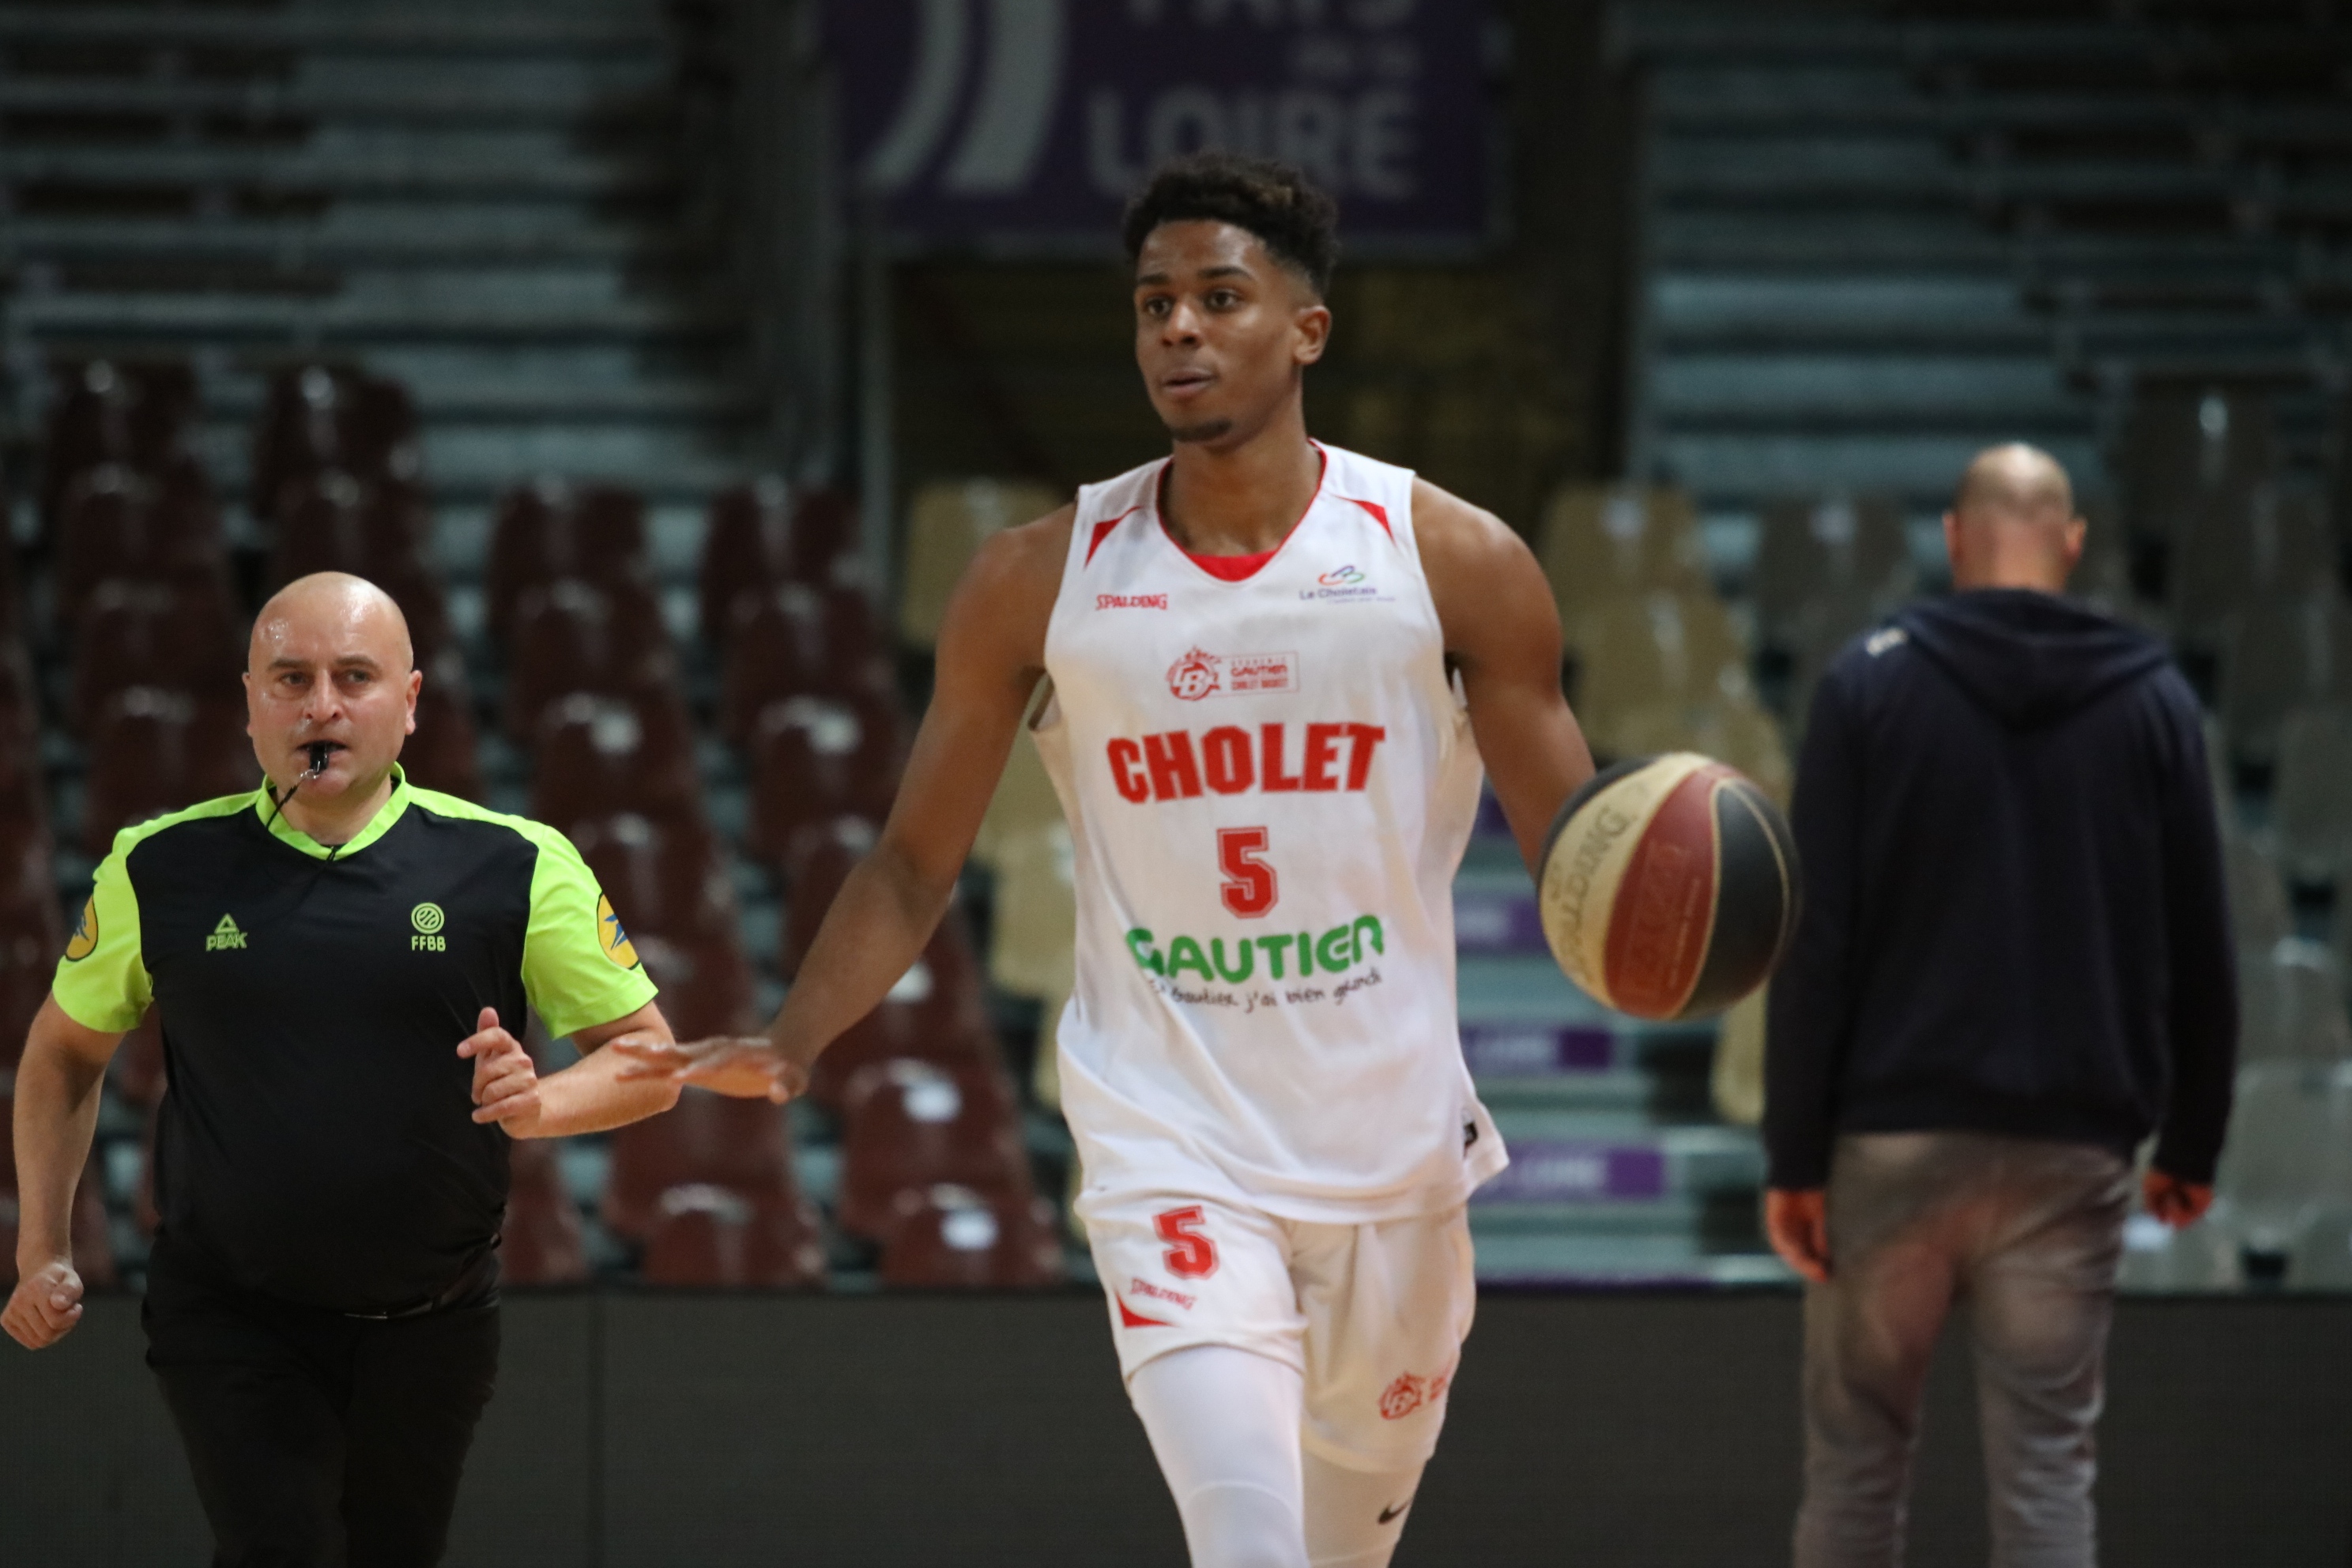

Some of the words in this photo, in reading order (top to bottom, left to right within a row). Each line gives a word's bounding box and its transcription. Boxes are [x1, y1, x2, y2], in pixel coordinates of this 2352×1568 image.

[1095, 594, 1167, 611] SPALDING
[1106, 722, 1386, 805] CHOLET
[1216, 825, 1279, 920] 5
[205, 932, 248, 952] PEAK
[411, 935, 447, 952] FFBB
[1125, 914, 1385, 984] GAUTIER
[1152, 1205, 1219, 1280] 5
